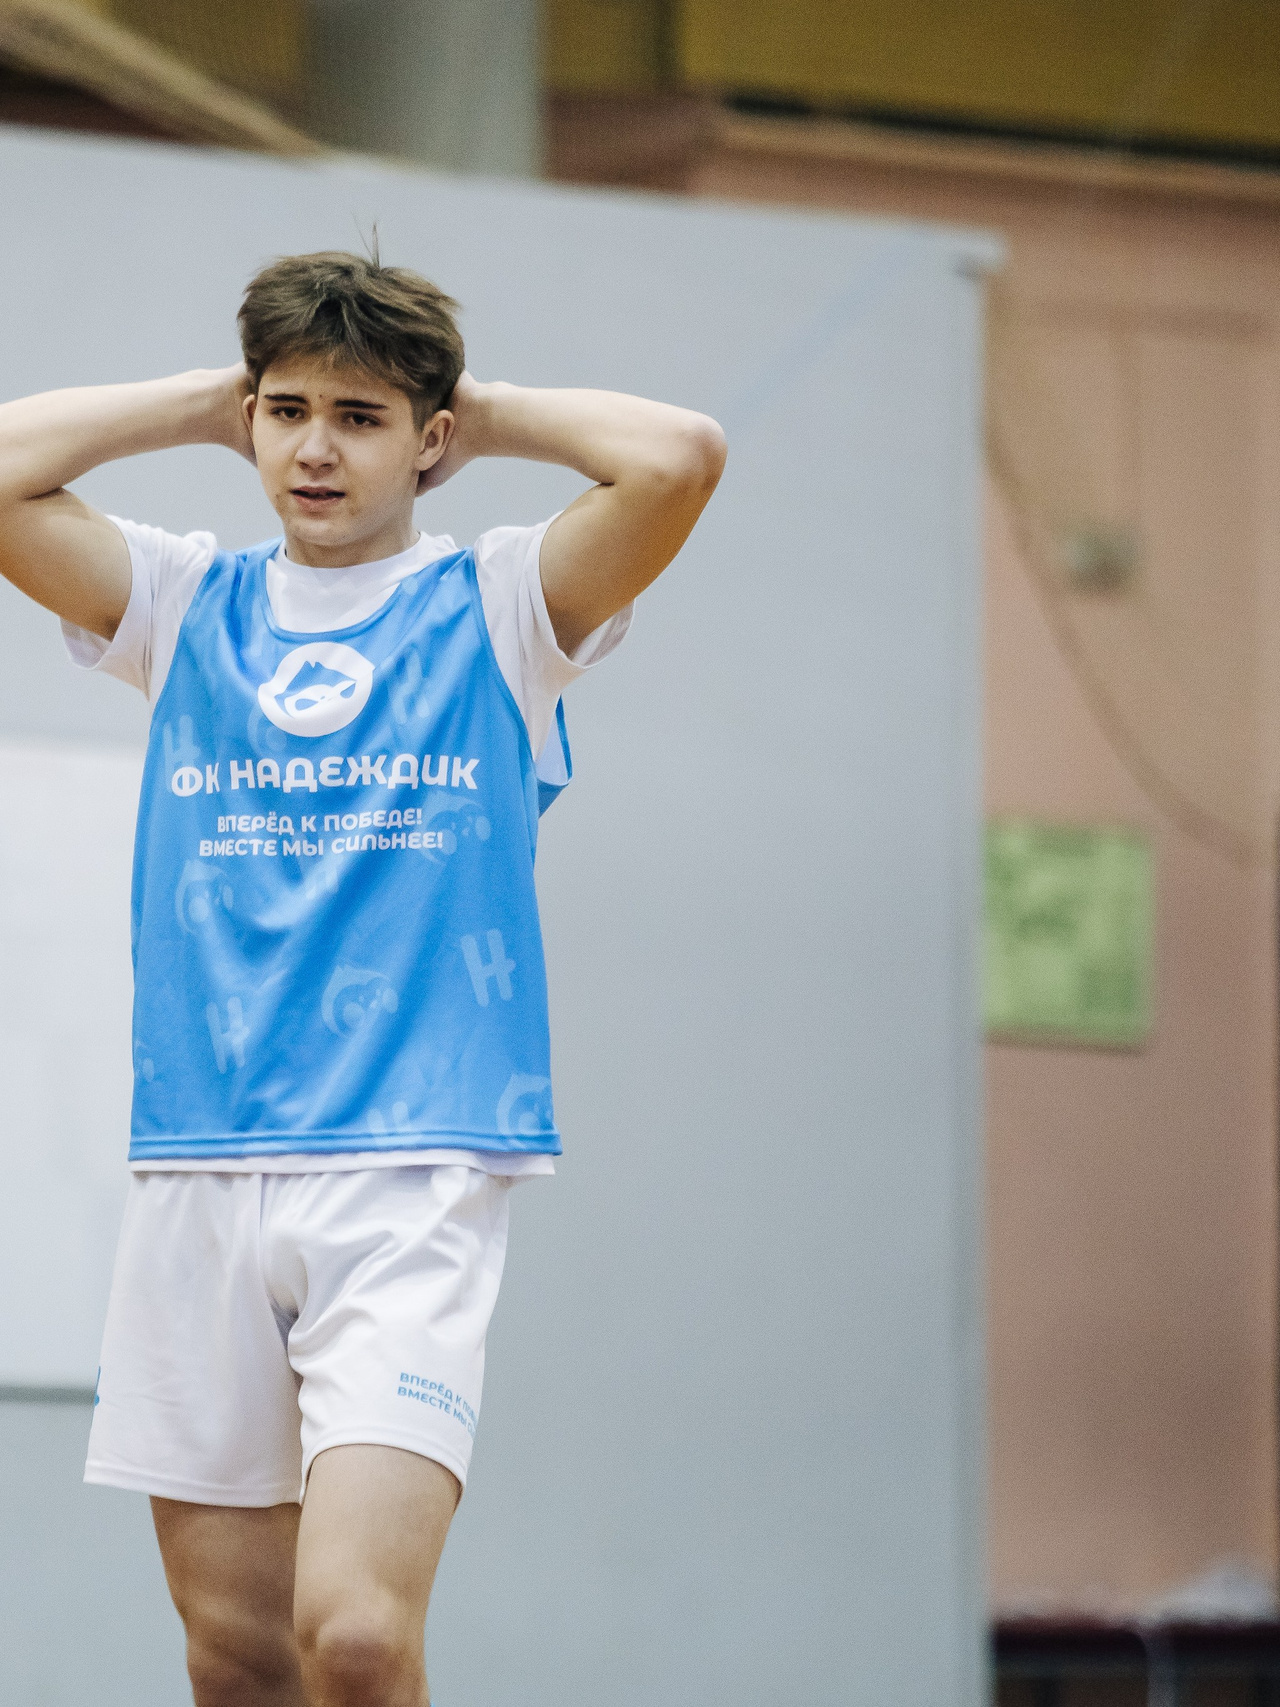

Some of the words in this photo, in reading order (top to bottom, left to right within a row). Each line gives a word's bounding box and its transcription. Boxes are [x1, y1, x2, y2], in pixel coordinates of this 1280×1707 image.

[171, 762, 220, 797] ФК
[230, 753, 480, 793] НАДЕЖДИК
[217, 811, 295, 836] ВПЕРЁД
[301, 815, 317, 833] К
[324, 807, 423, 832] ПОБЕДЕ!
[199, 838, 278, 857] ВМЕСТЕ
[282, 839, 324, 857] МЫ
[331, 831, 443, 855] СИЛЬНЕЕ!
[397, 1386, 451, 1414] ВМЕСТЕ
[400, 1372, 453, 1402] ВПЕРЁД
